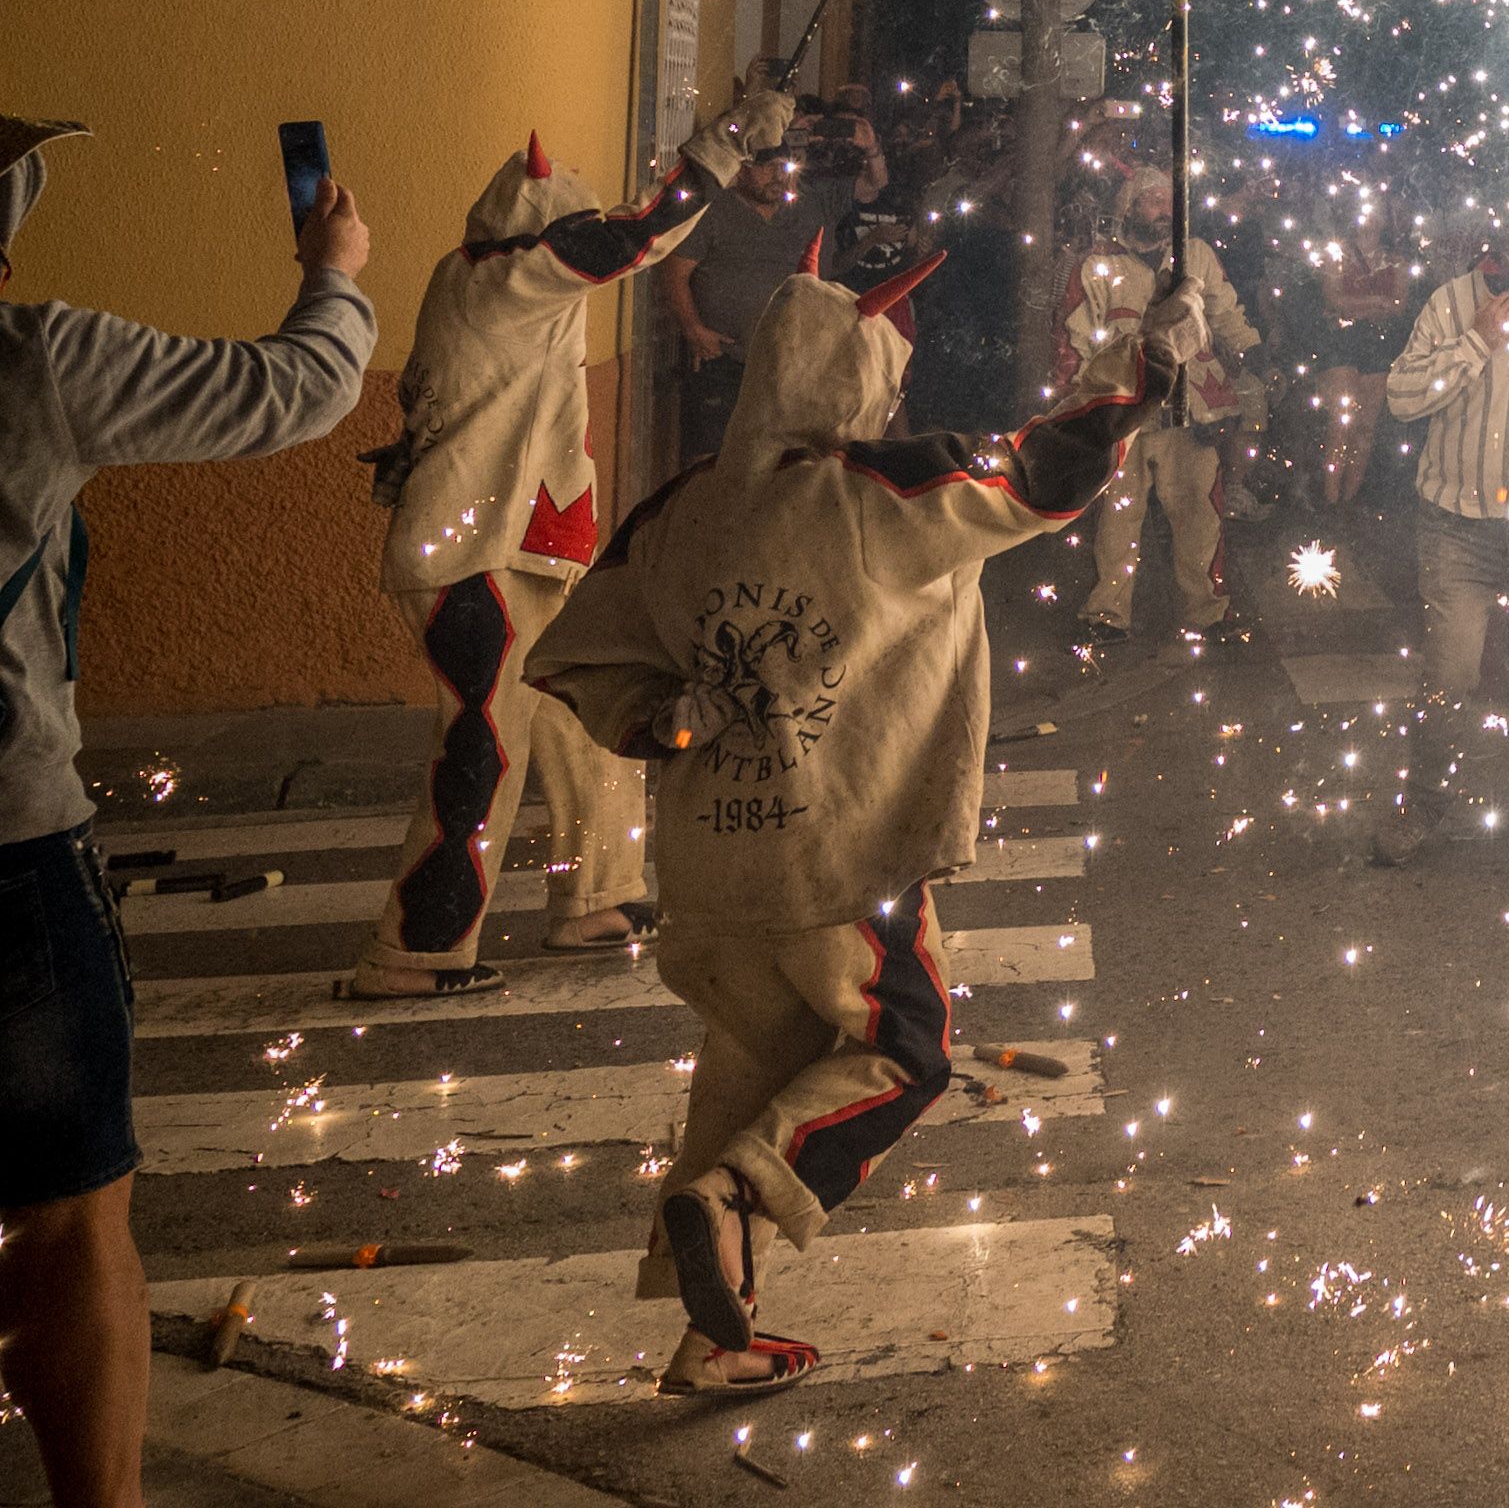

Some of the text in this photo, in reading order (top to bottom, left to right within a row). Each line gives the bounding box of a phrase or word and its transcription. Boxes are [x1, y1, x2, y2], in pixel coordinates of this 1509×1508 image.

[700, 582, 848, 784] ONIS DE NTBLANC
[696, 795, 809, 834] -1984-
